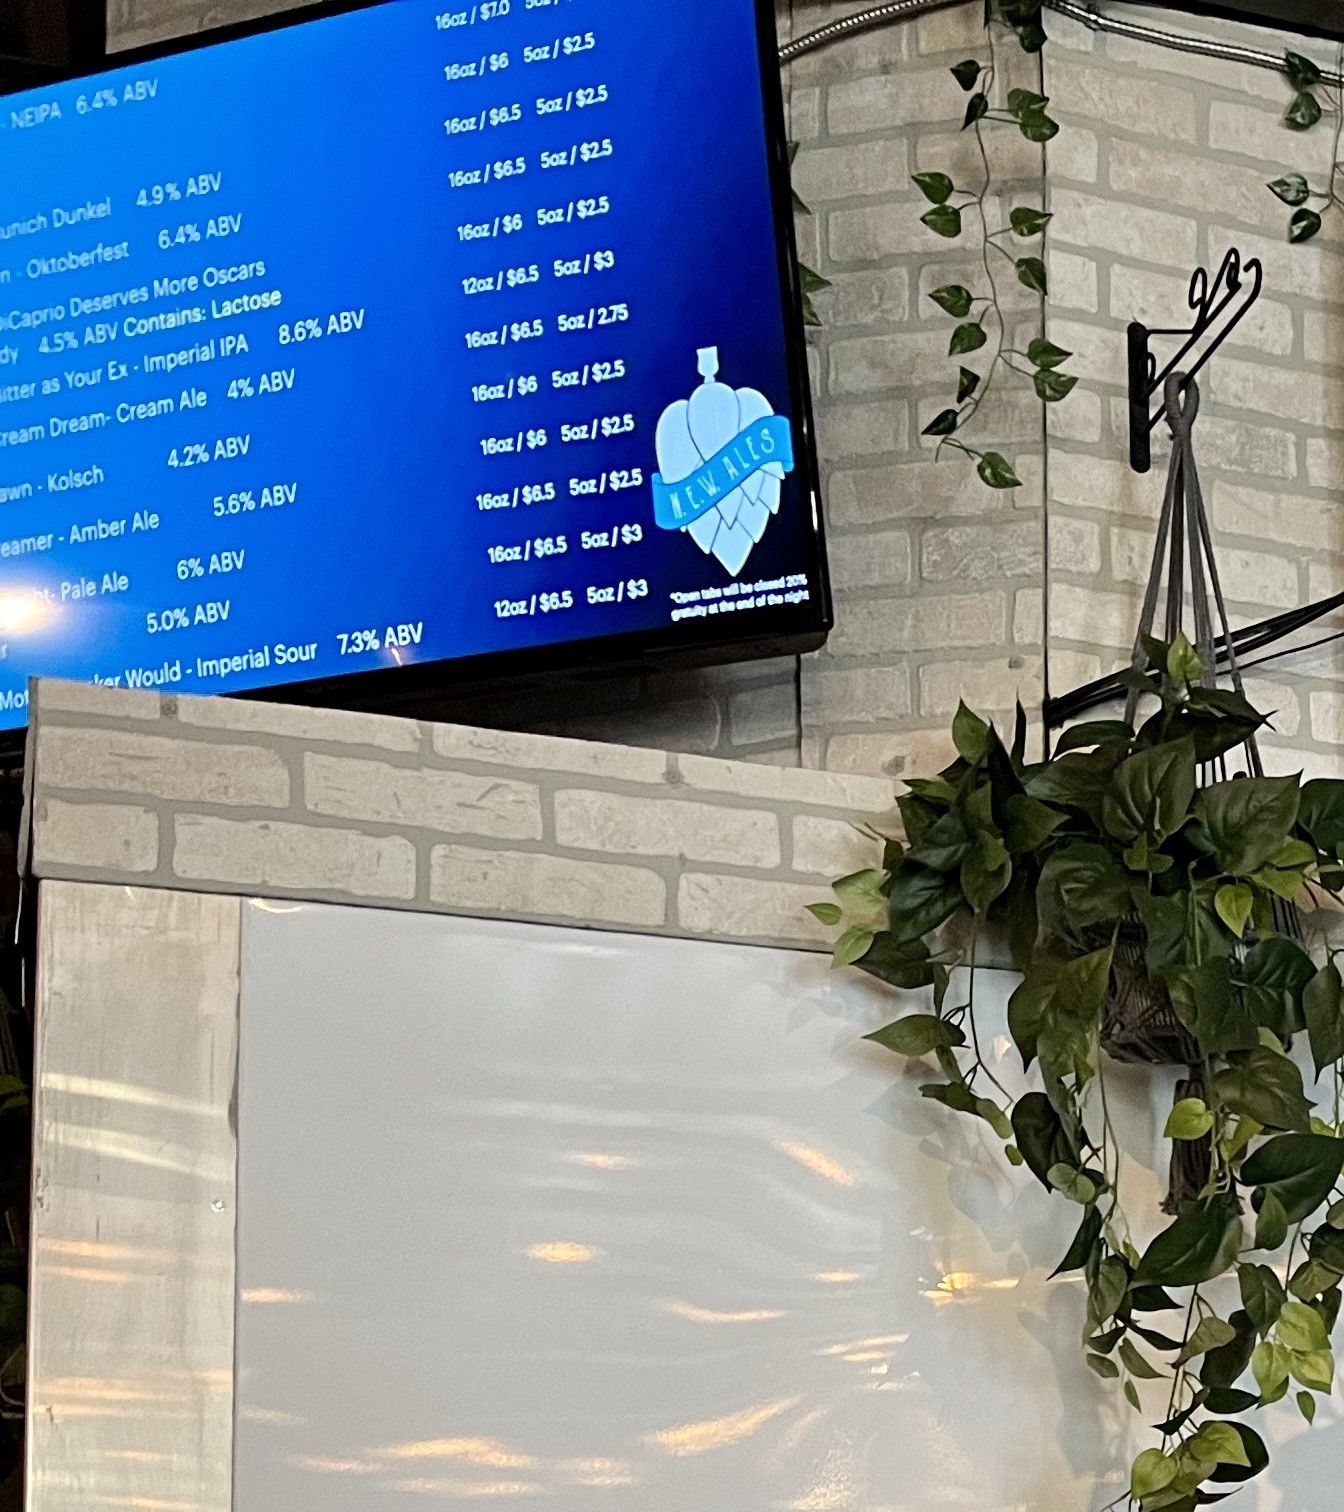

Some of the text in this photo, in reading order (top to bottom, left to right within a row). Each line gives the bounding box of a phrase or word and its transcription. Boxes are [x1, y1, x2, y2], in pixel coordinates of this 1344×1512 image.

[444, 32, 595, 80] 16oz $6 5oz $2.5
[52, 172, 221, 228] Dunkel 4.9% ABV
[27, 213, 242, 278] Oktoberfest 6.4% ABV
[39, 290, 282, 353] 4.5% ABV Contains: Lactose
[64, 309, 365, 388] Your Ex Imperial IPA 8.6% ABV
[727, 428, 775, 481] ALES
[70, 483, 297, 544] Amber Ale 5.6% ABV
[494, 598, 527, 617] 12oz
[540, 591, 573, 613] $6.5
[587, 586, 615, 604] 5oz
[627, 579, 648, 599] $3
